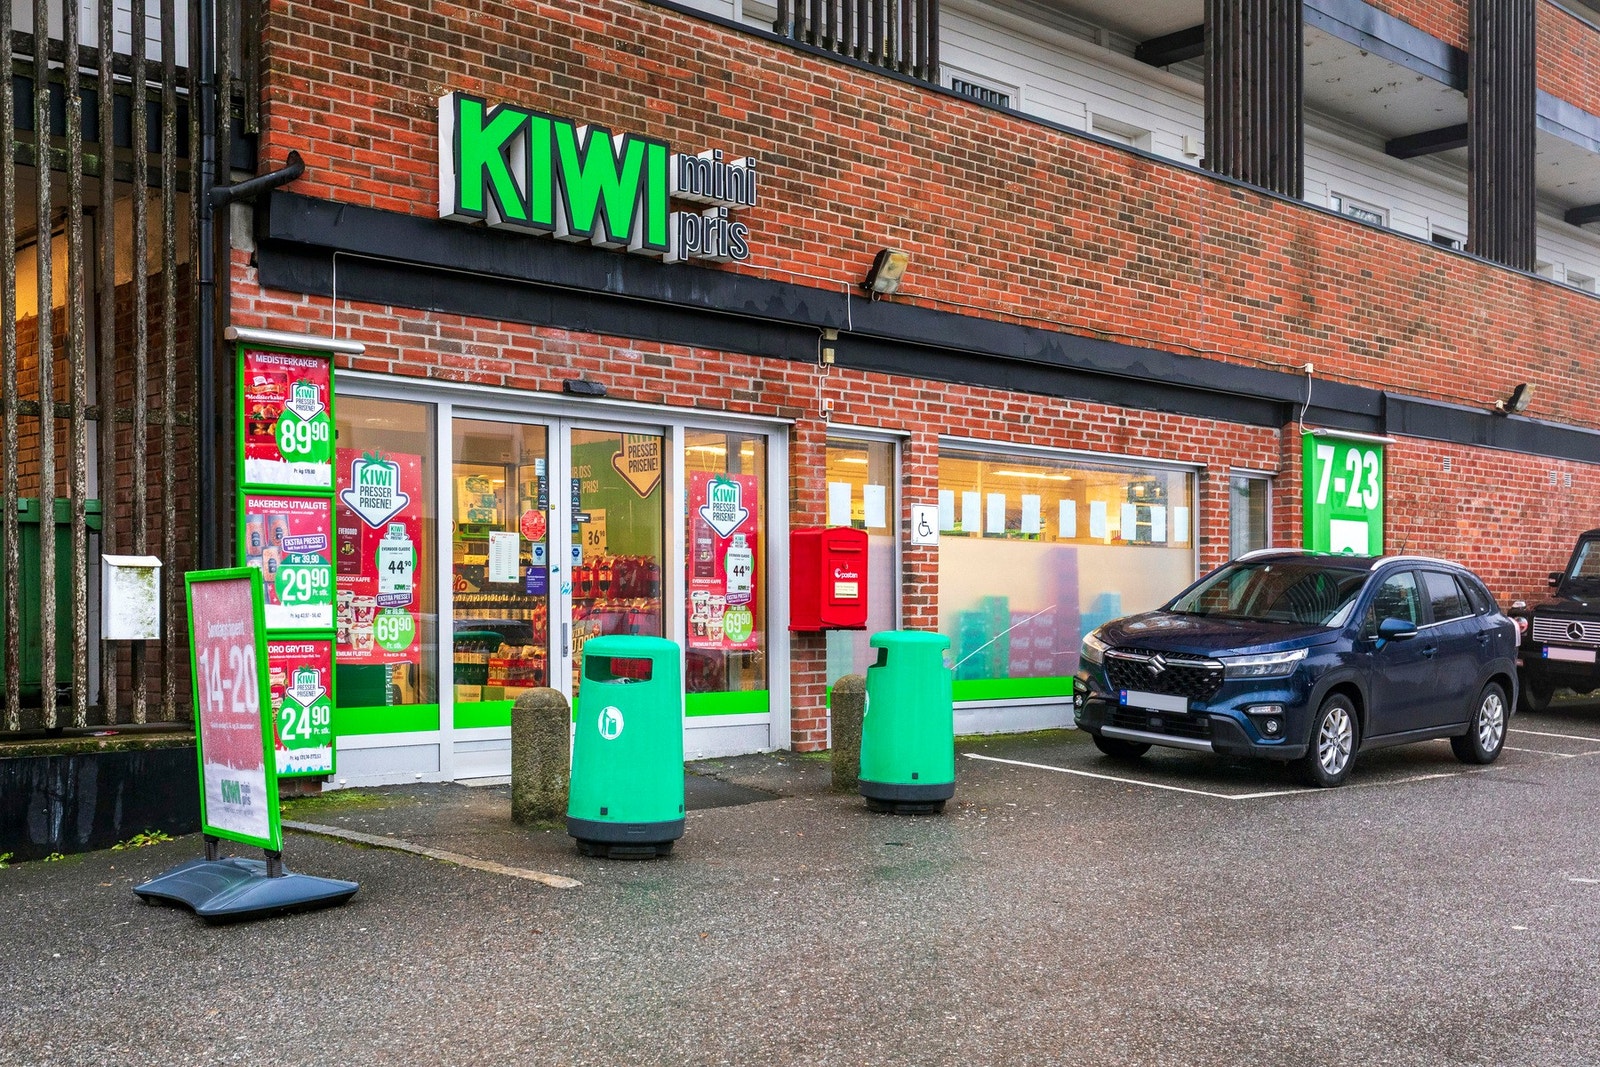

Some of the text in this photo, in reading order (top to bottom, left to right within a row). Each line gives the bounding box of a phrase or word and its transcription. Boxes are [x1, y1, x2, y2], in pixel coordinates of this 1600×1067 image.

[442, 92, 670, 258] KIWI
[678, 149, 756, 206] mini
[678, 207, 749, 261] pris
[256, 354, 318, 368] MEDISTERKAKER
[296, 388, 315, 399] KIWI
[296, 398, 315, 406] PRESSER
[628, 443, 657, 458] PRESSER
[628, 457, 659, 473] PRISENE!
[360, 469, 392, 486] KIWI
[1316, 444, 1380, 511] 7-23
[360, 485, 392, 498] PRESSER
[582, 479, 599, 494] PRIS!
[713, 488, 736, 502] KIWI
[249, 499, 327, 510] BAKERENS UTVALGTE
[359, 497, 392, 509] PRISENE!
[713, 502, 736, 512] PRESSER
[713, 511, 736, 522] PRISENE!
[302, 554, 320, 564] 39,90
[285, 645, 314, 653] GRYTER
[199, 644, 259, 714] 14-20
[297, 675, 316, 684] KIWI
[221, 779, 241, 805] KIWI
